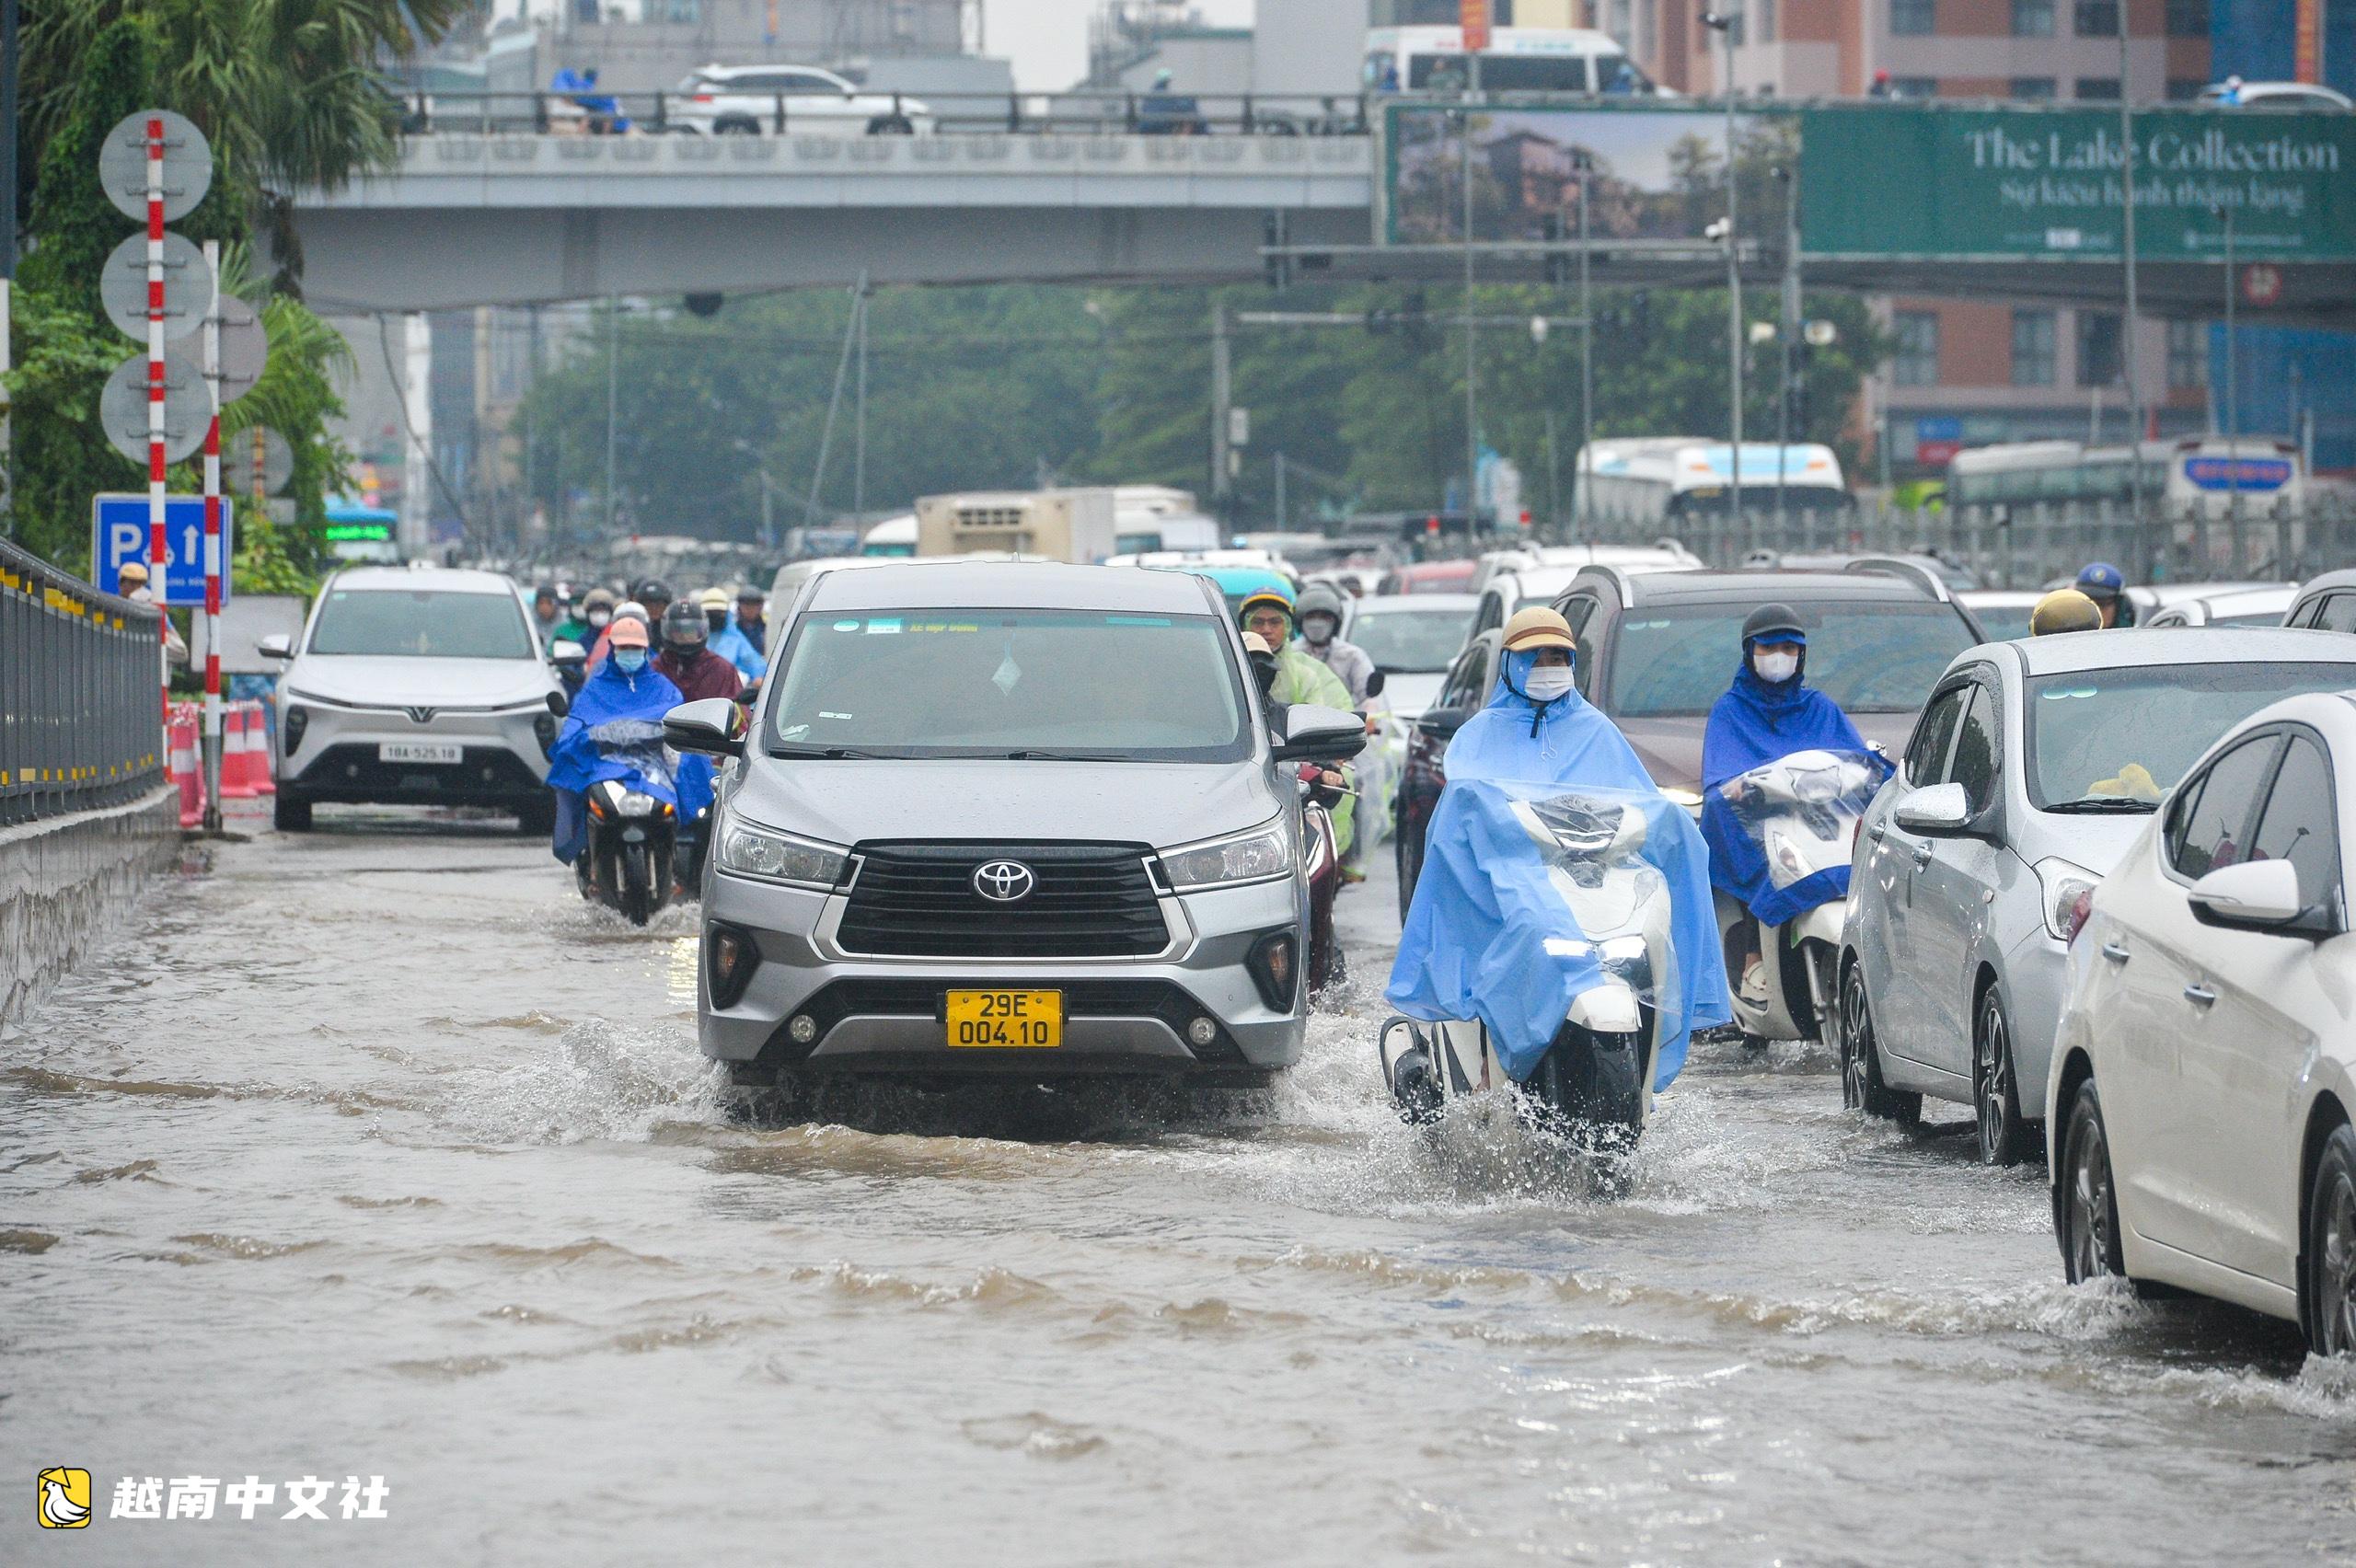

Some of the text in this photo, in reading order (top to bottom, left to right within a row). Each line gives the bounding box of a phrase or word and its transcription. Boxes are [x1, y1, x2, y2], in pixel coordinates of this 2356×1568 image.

[1965, 126, 2339, 171] The Lake Collection
[111, 524, 143, 568] P
[980, 995, 1027, 1017] 29E
[960, 1021, 1047, 1043] 004.10
